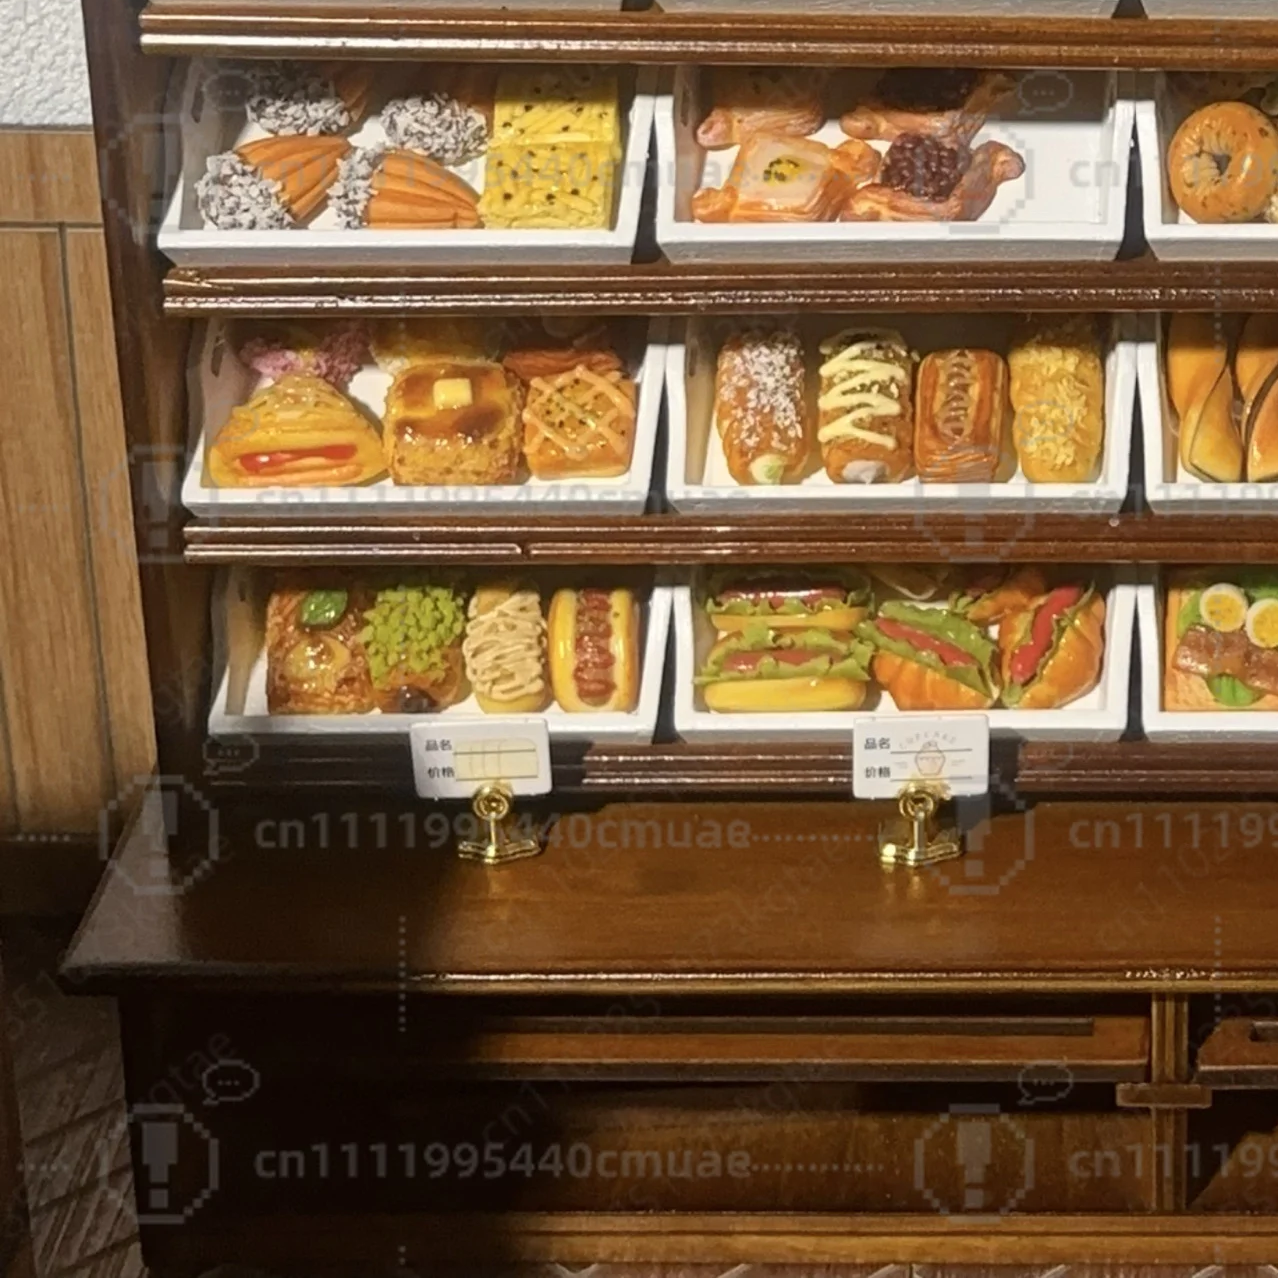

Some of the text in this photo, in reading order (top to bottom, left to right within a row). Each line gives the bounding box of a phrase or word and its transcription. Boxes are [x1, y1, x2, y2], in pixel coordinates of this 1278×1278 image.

[425, 739, 452, 752] 品名
[864, 737, 891, 750] 品名
[427, 766, 455, 778] 价格
[865, 766, 891, 779] 价格
